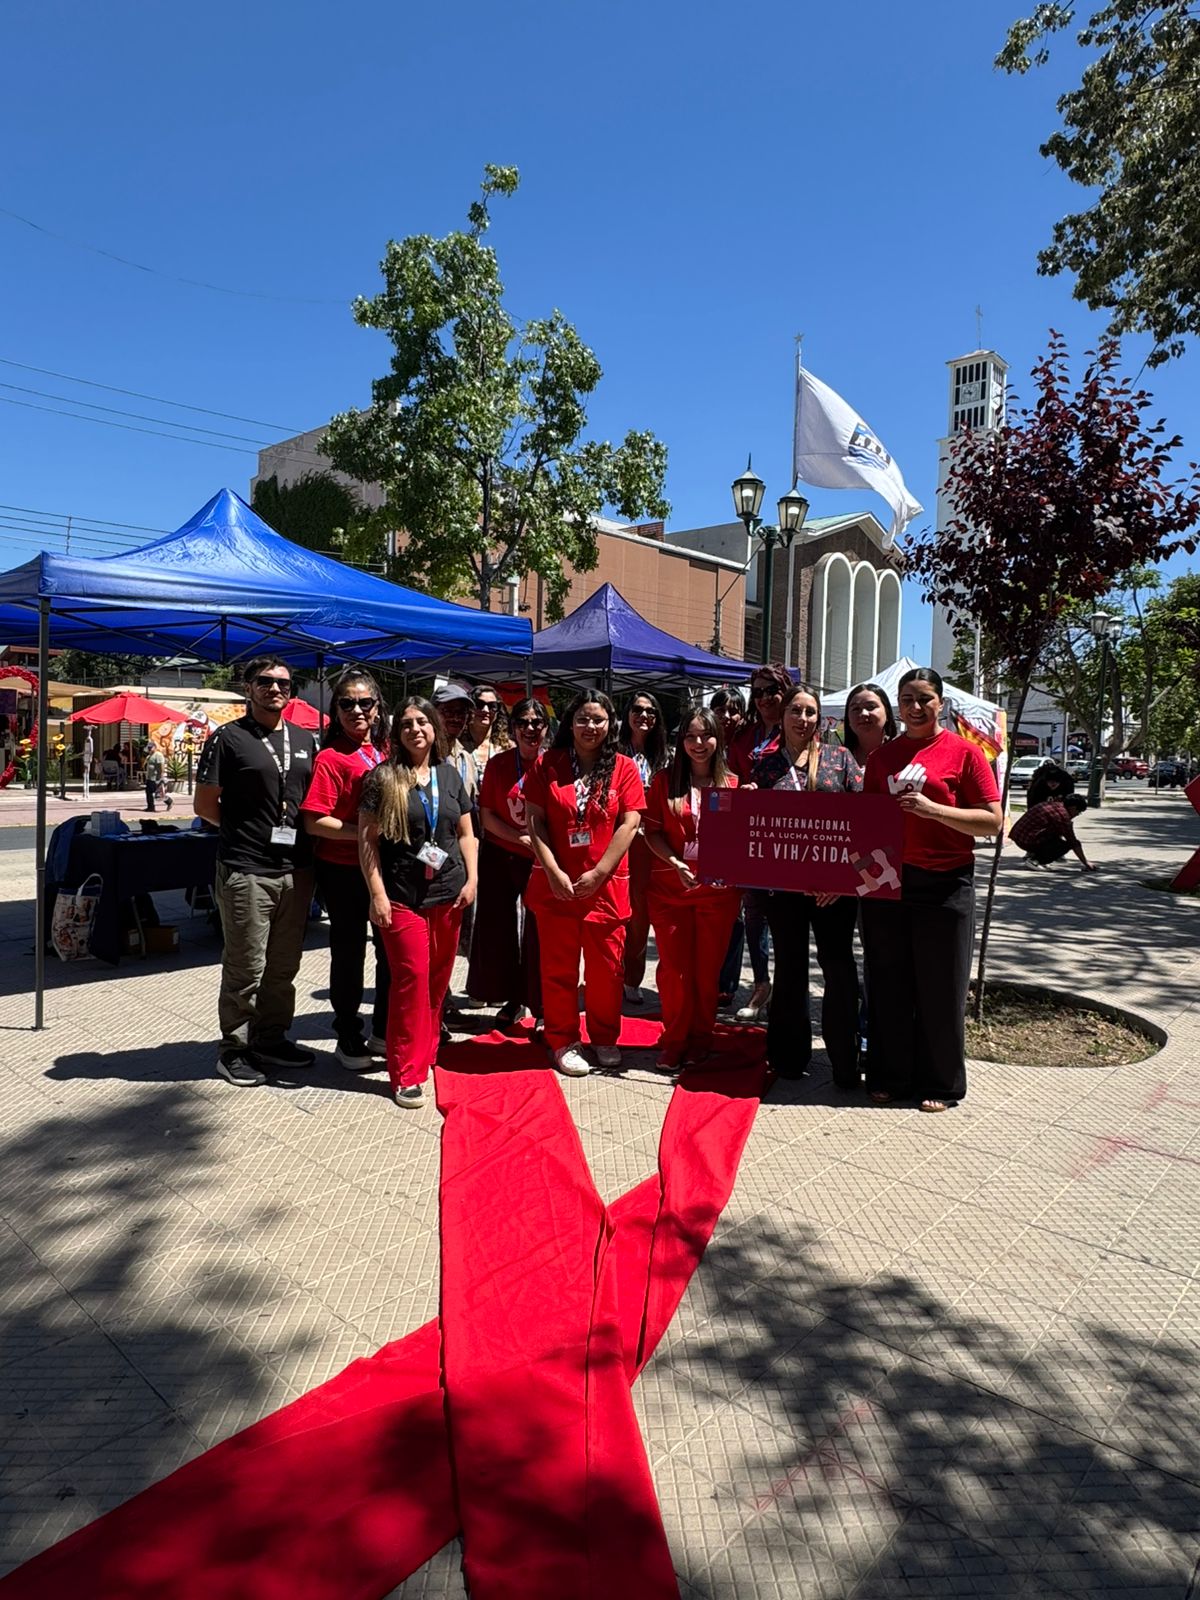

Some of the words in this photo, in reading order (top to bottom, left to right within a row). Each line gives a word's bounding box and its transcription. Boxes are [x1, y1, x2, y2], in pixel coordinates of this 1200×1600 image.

[749, 814, 766, 827] DÍA
[771, 817, 852, 832] INTERNACIONAL
[749, 830, 760, 838] DE
[764, 831, 775, 839] LA
[779, 832, 809, 840] LUCHA
[813, 834, 852, 843] CONTRA
[748, 841, 764, 858] EL
[773, 842, 850, 864] VIH/SIDA
